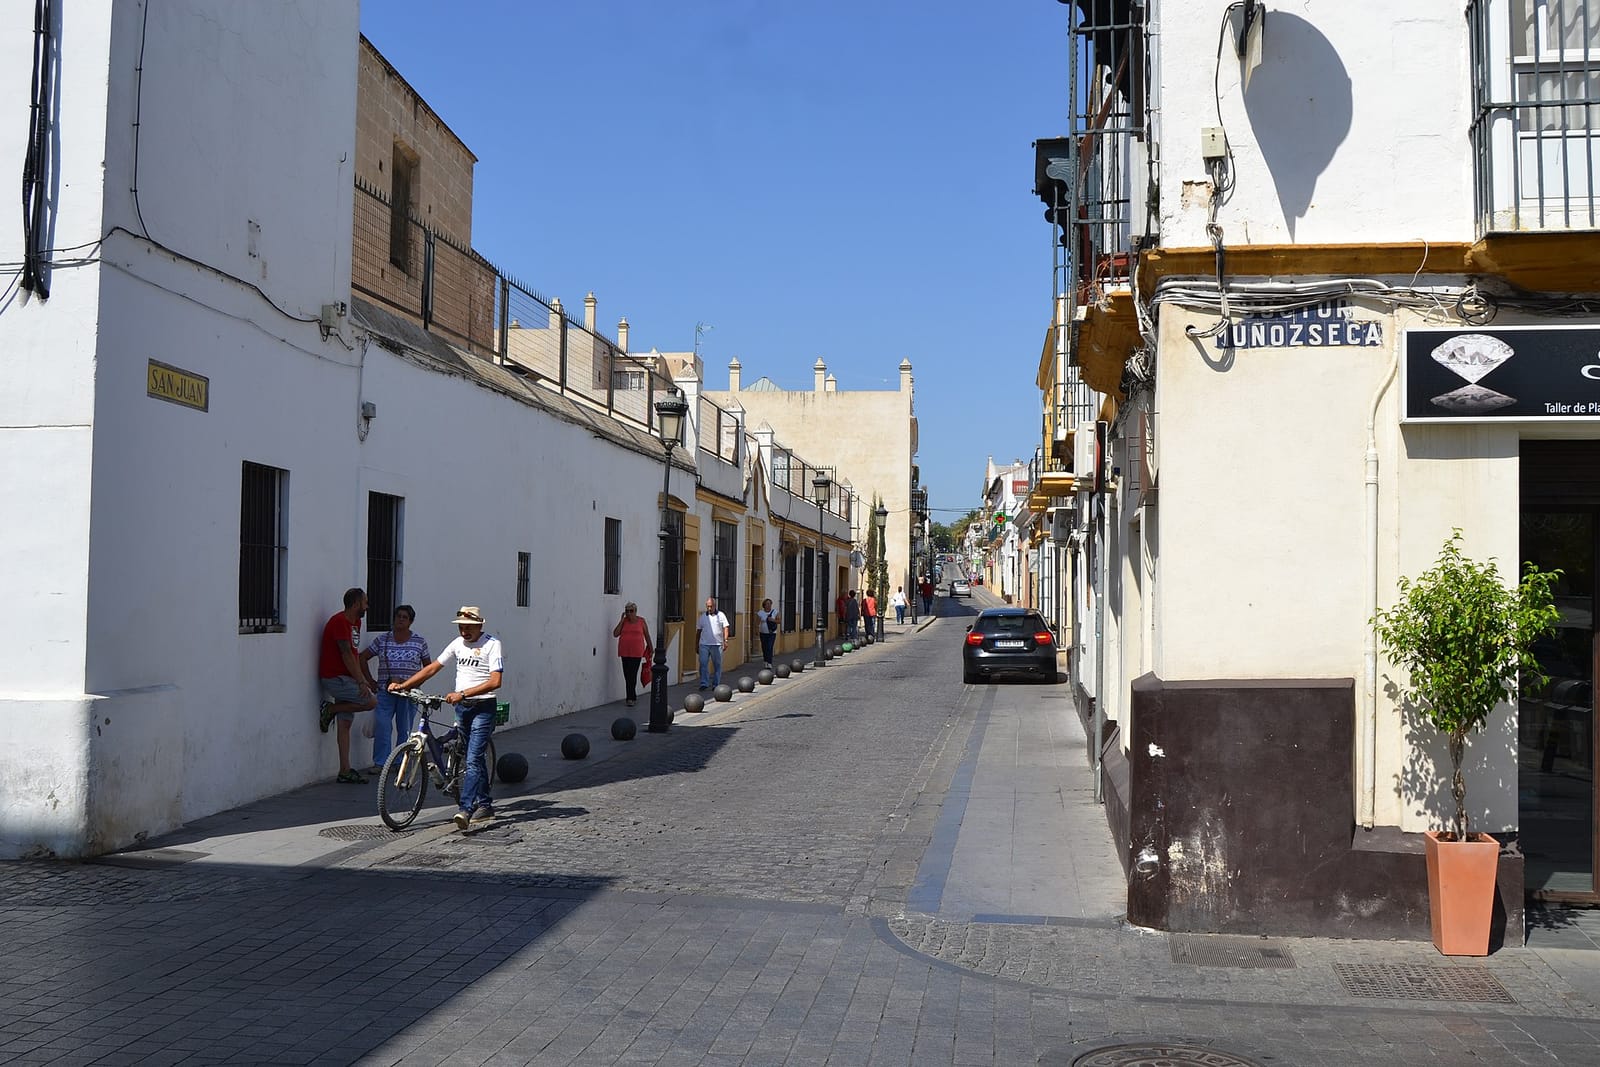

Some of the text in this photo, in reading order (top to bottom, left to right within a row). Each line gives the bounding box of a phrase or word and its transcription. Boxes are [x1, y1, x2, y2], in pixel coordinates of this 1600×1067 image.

[151, 369, 203, 403] SAN JUAN
[1544, 402, 1572, 413] Taller
[1573, 402, 1586, 413] de
[456, 655, 479, 667] win
